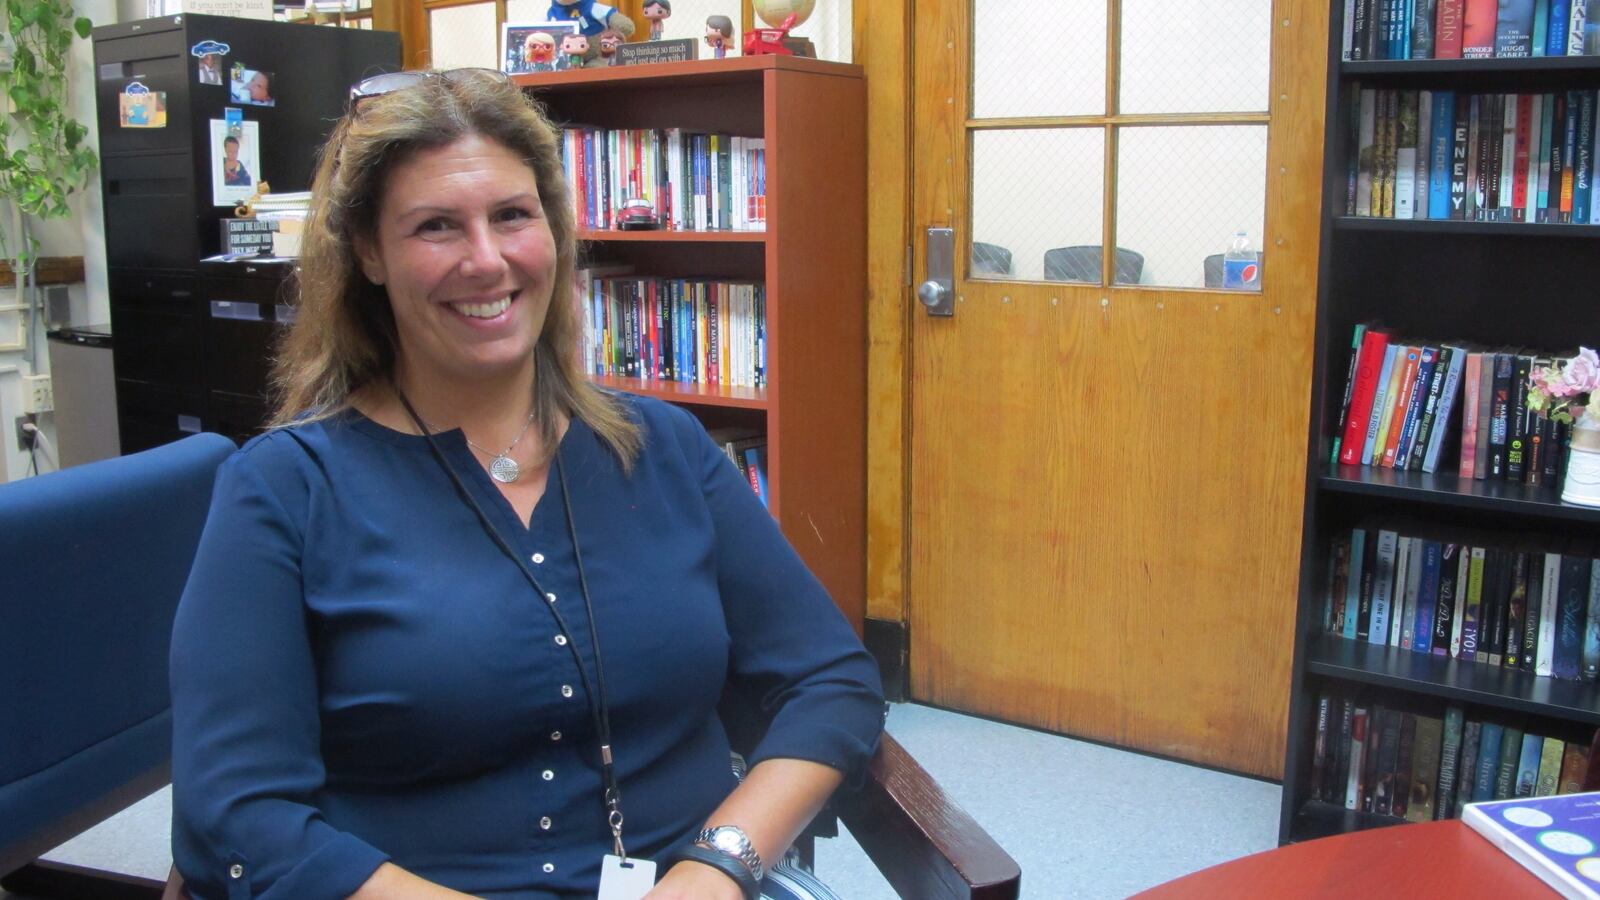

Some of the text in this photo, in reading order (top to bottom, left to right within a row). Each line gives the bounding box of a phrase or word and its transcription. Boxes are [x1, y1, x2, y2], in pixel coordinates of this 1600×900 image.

[622, 48, 635, 58] Stop
[636, 46, 660, 57] thinking
[669, 43, 687, 53] much
[668, 54, 681, 63] with
[1580, 97, 1591, 145] ANDERSON
[1452, 128, 1467, 210] ENEMY
[1552, 147, 1561, 173] TWISTED
[231, 233, 240, 244] FOR
[262, 233, 272, 244] YOU
[1366, 419, 1377, 439] FOSTER
[1491, 417, 1499, 443] WORLD
[1497, 403, 1506, 436] MARCELO
[1376, 603, 1384, 615] ONE
[1463, 628, 1478, 654] ¡YO!
[1525, 610, 1535, 649] LEGACIES
[1478, 756, 1493, 792] shiver
[1498, 762, 1514, 798] linger
